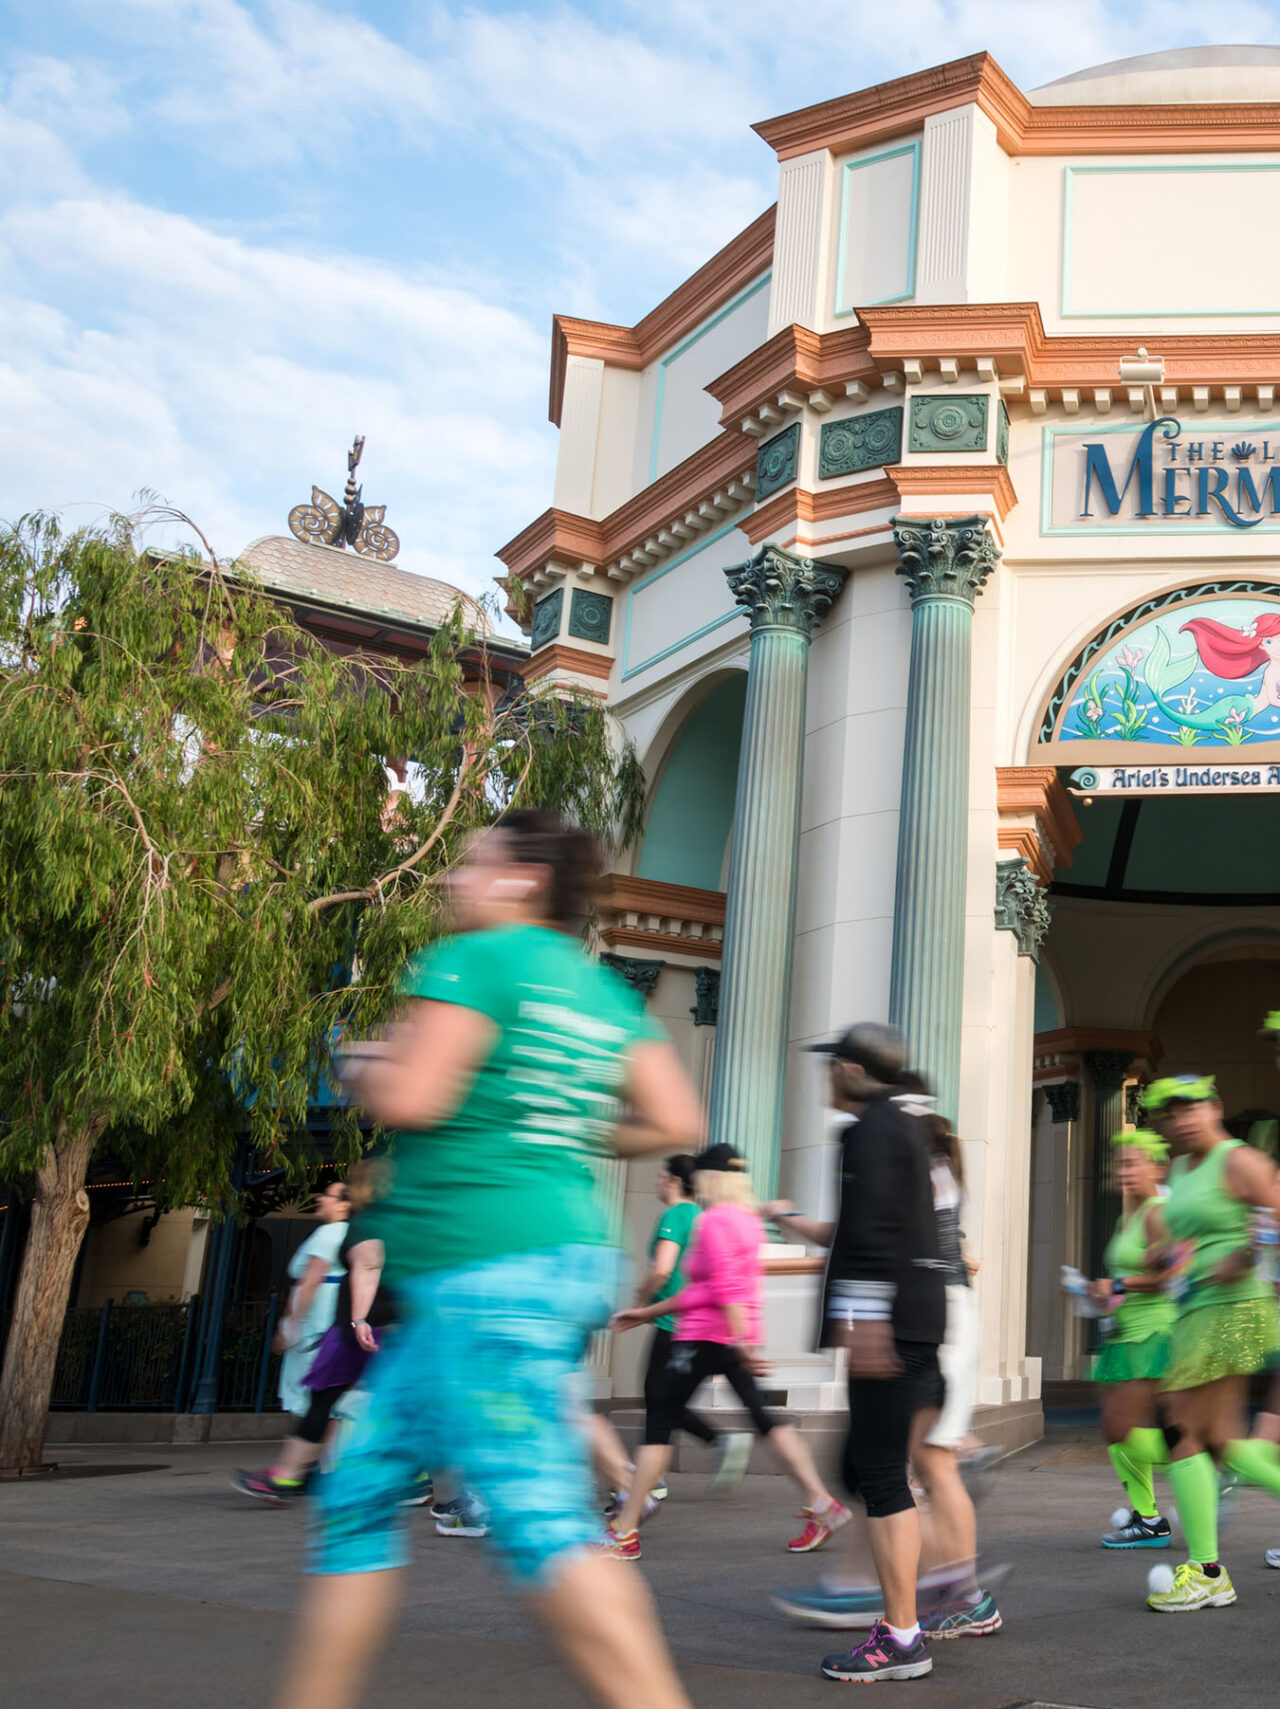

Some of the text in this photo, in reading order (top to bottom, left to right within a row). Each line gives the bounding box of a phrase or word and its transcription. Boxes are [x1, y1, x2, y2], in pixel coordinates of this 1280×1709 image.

[1166, 441, 1225, 461] THE
[1112, 767, 1170, 788] Ariel's
[1175, 767, 1261, 787] Undersea
[865, 1649, 889, 1668] N
